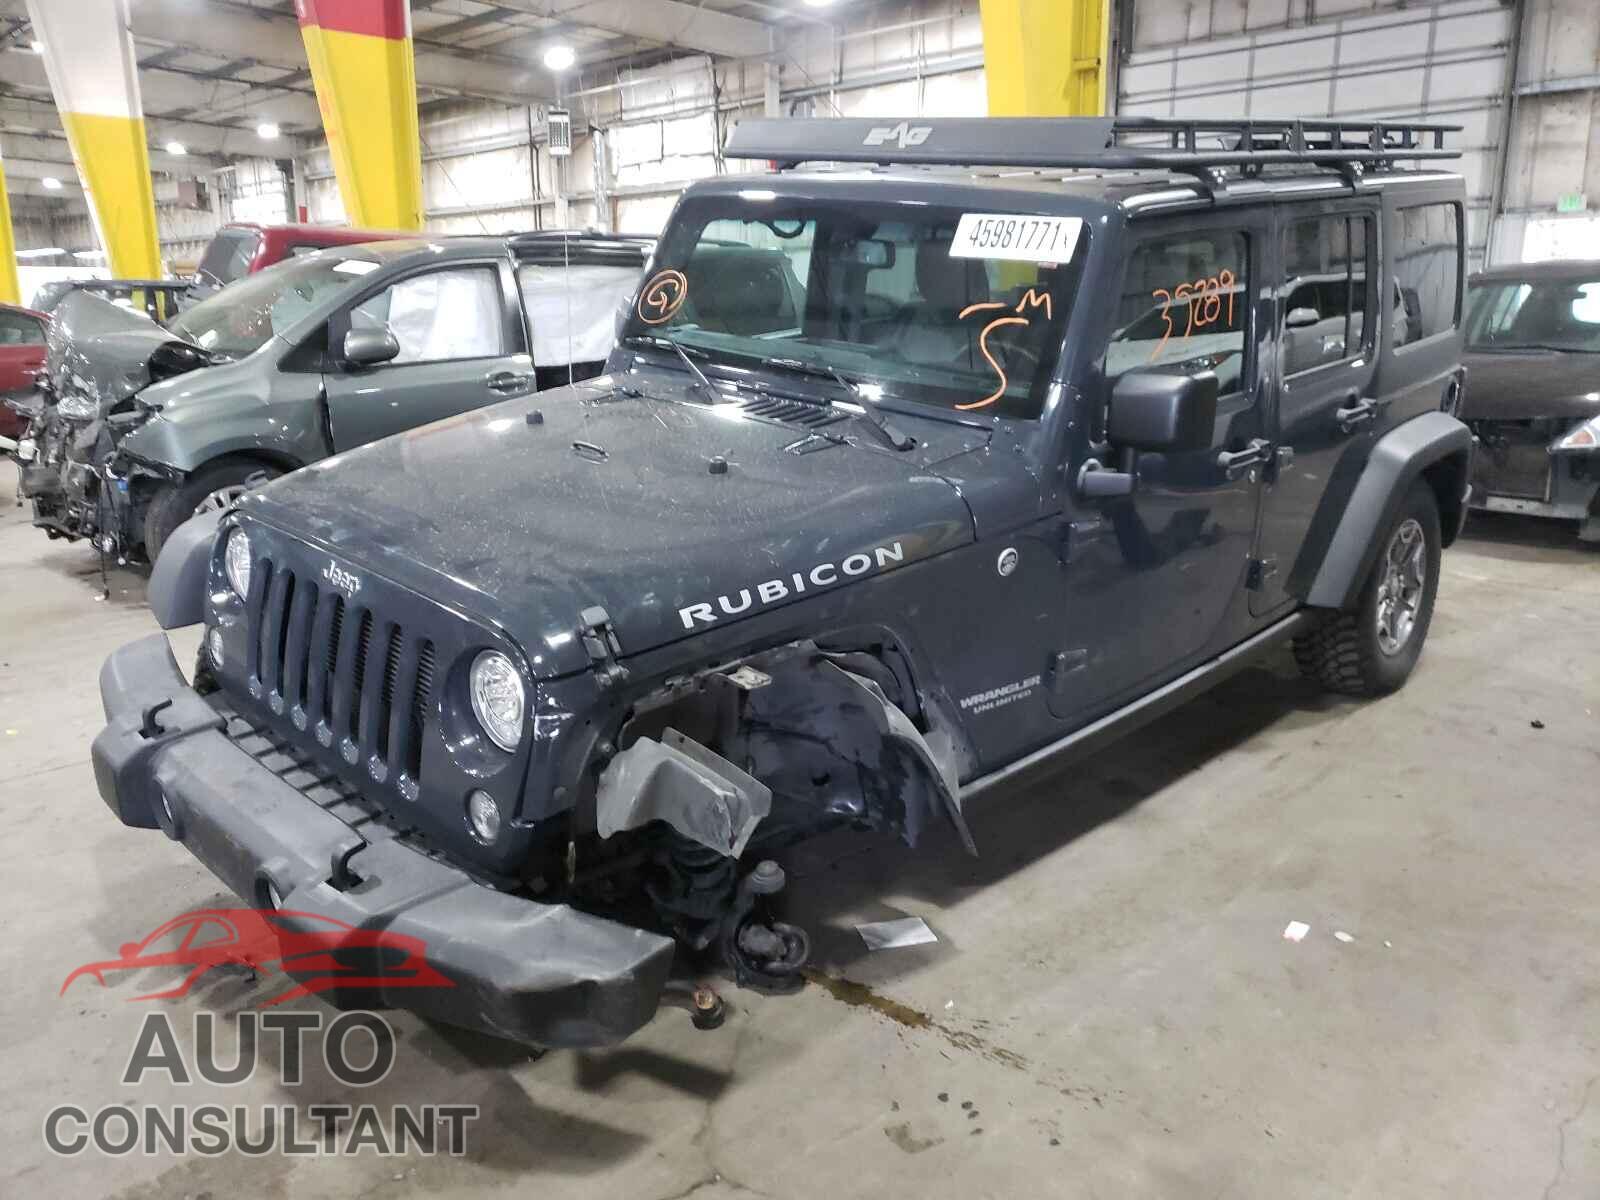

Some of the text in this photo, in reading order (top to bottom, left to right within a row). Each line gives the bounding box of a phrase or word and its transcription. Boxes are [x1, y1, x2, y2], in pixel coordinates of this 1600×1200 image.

[678, 541, 904, 630] RUBICON
[959, 674, 1041, 709] WRANGLER
[973, 688, 1032, 715] UNLIMITED
